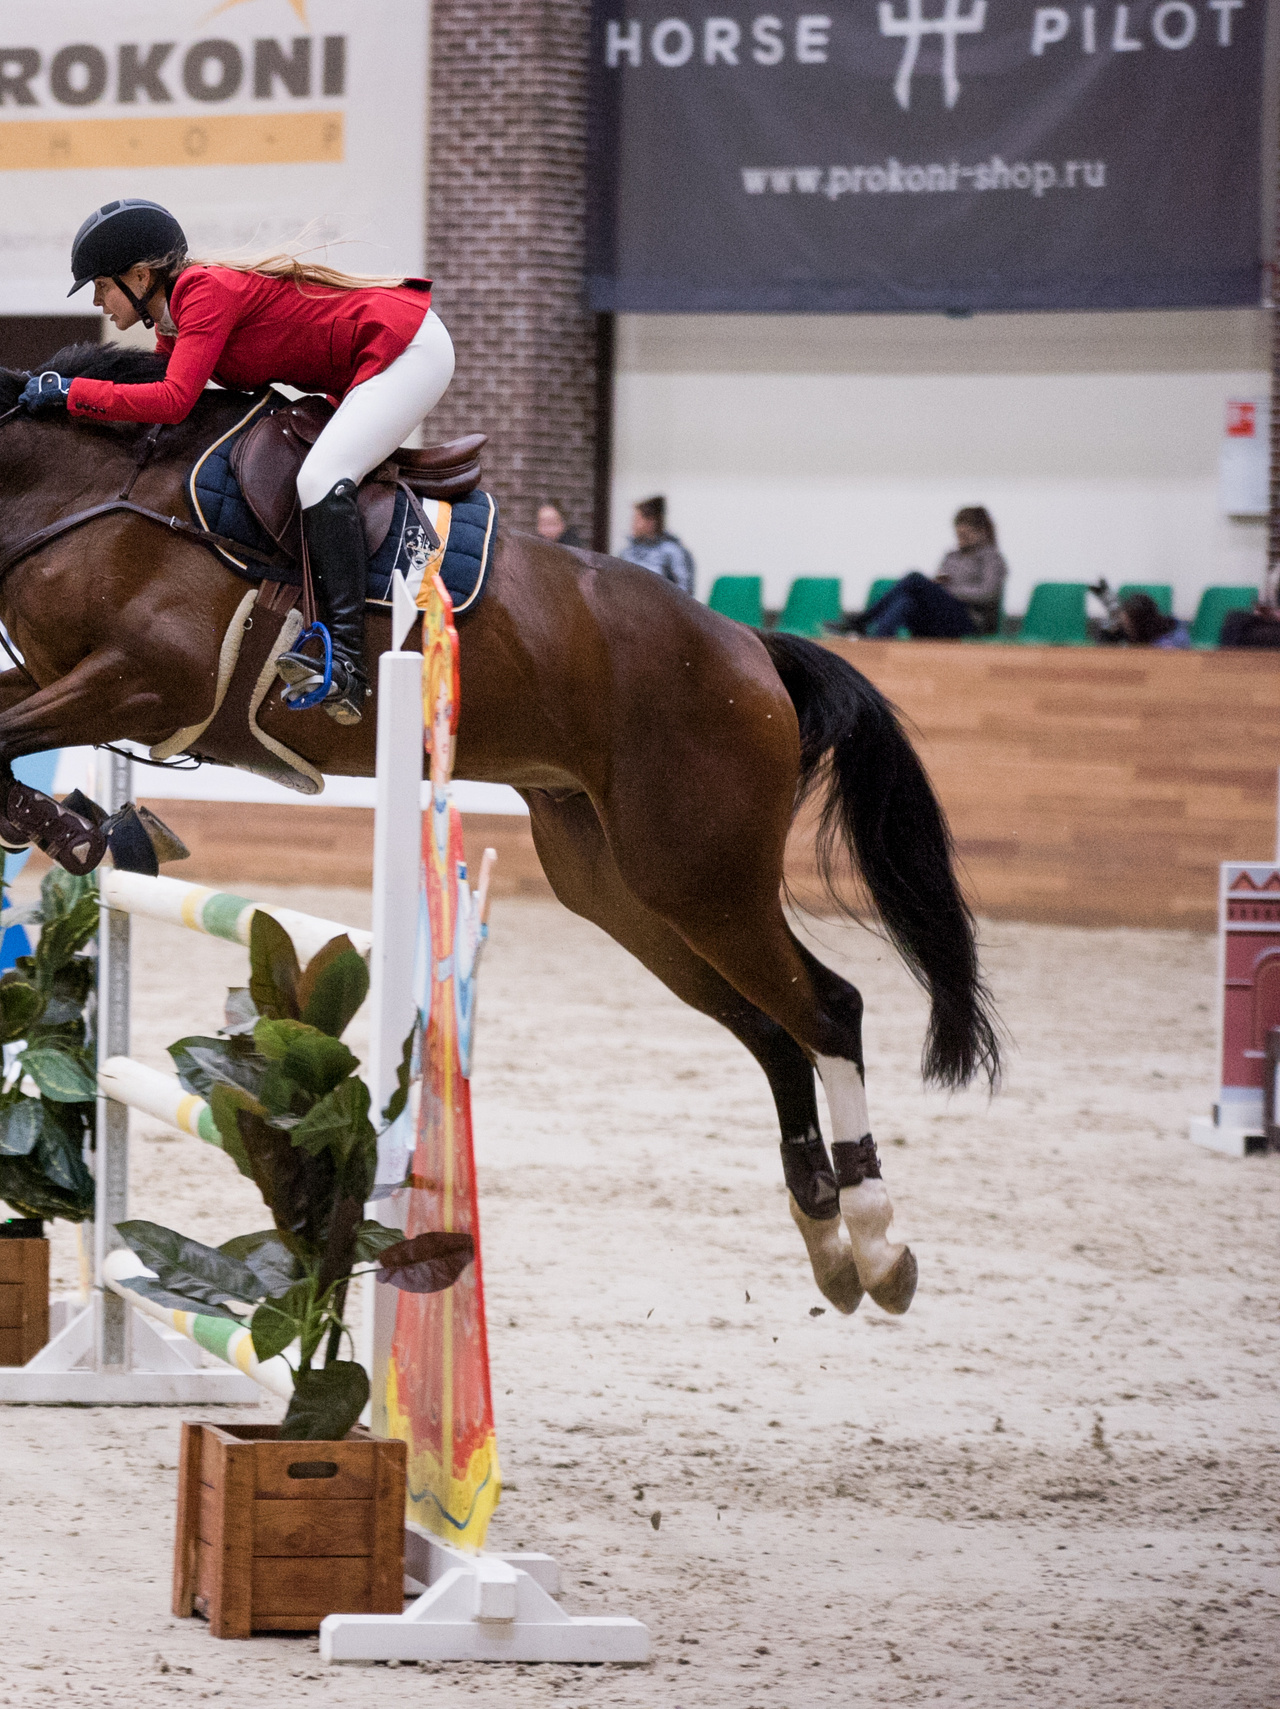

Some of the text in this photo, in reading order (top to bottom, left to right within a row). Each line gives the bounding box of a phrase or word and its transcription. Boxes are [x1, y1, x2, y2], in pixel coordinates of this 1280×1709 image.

[606, 1, 1244, 68] HORSE PILOT
[741, 157, 1106, 199] www.prokoni-shop.ru
